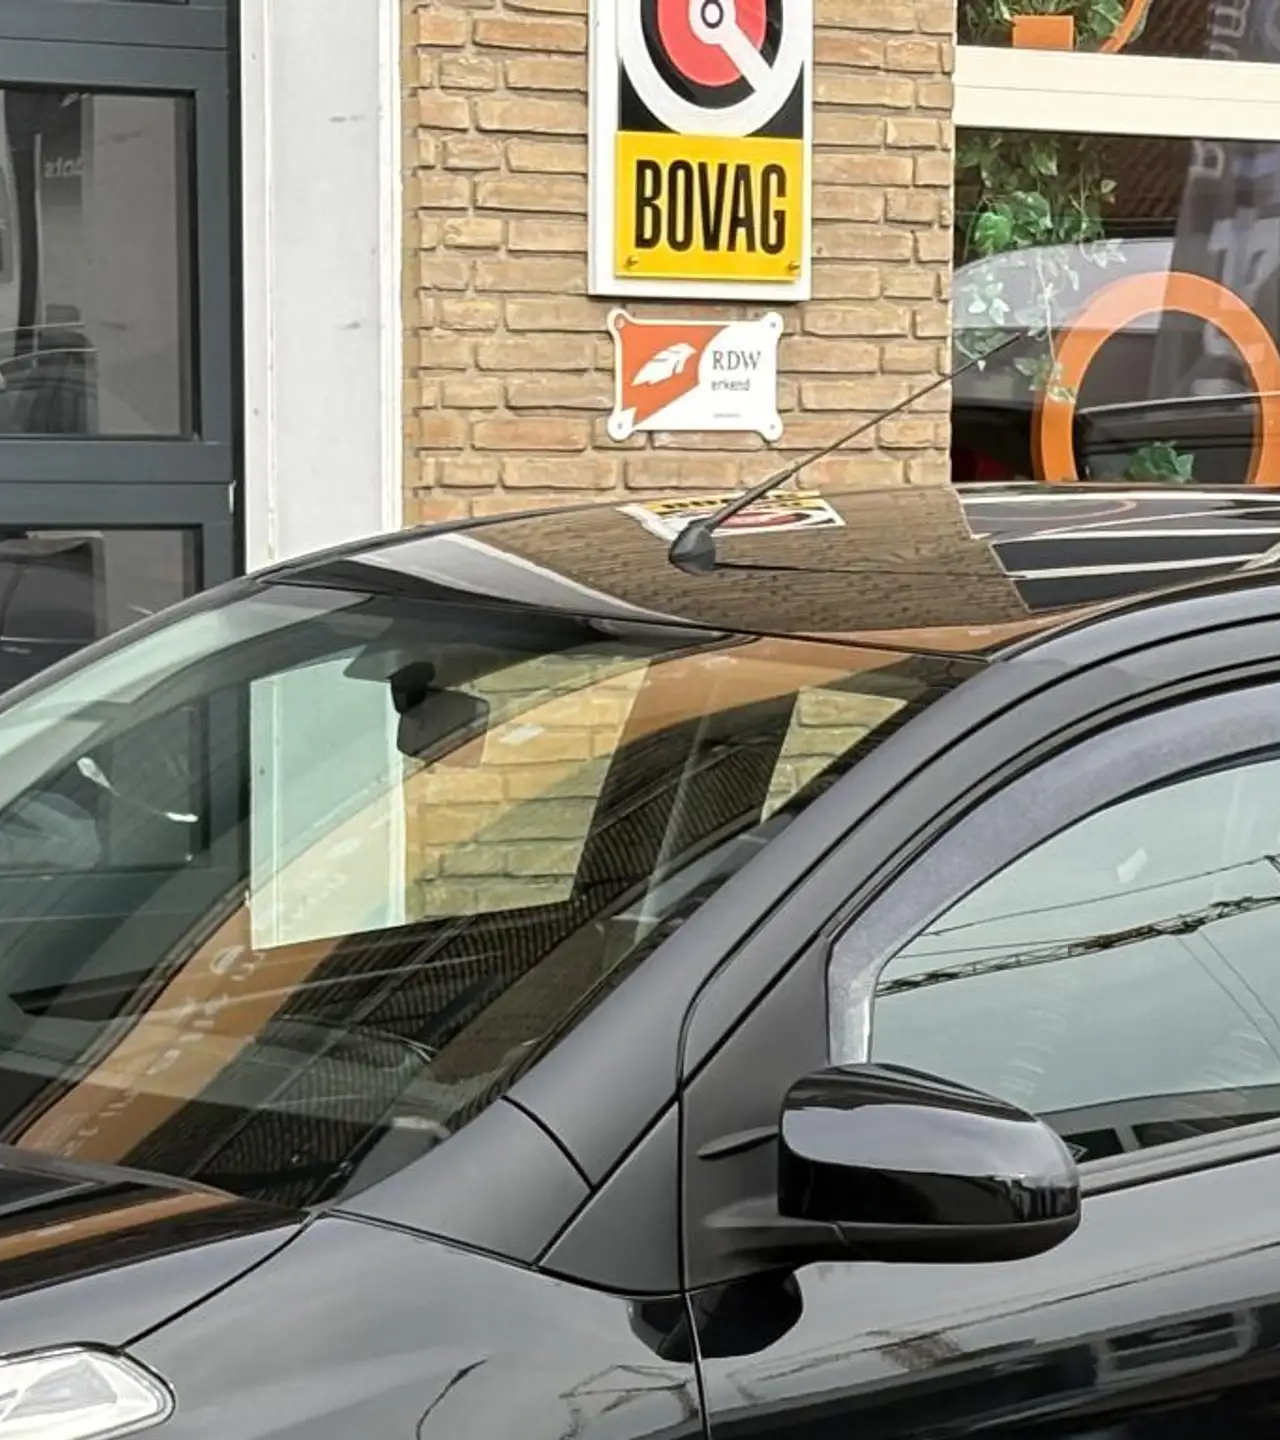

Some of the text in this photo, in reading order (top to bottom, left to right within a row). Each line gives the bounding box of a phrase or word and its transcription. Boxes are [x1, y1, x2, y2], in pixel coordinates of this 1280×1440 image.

[634, 159, 788, 255] BOVAG
[712, 350, 762, 371] RDW
[711, 377, 751, 391] erkend
